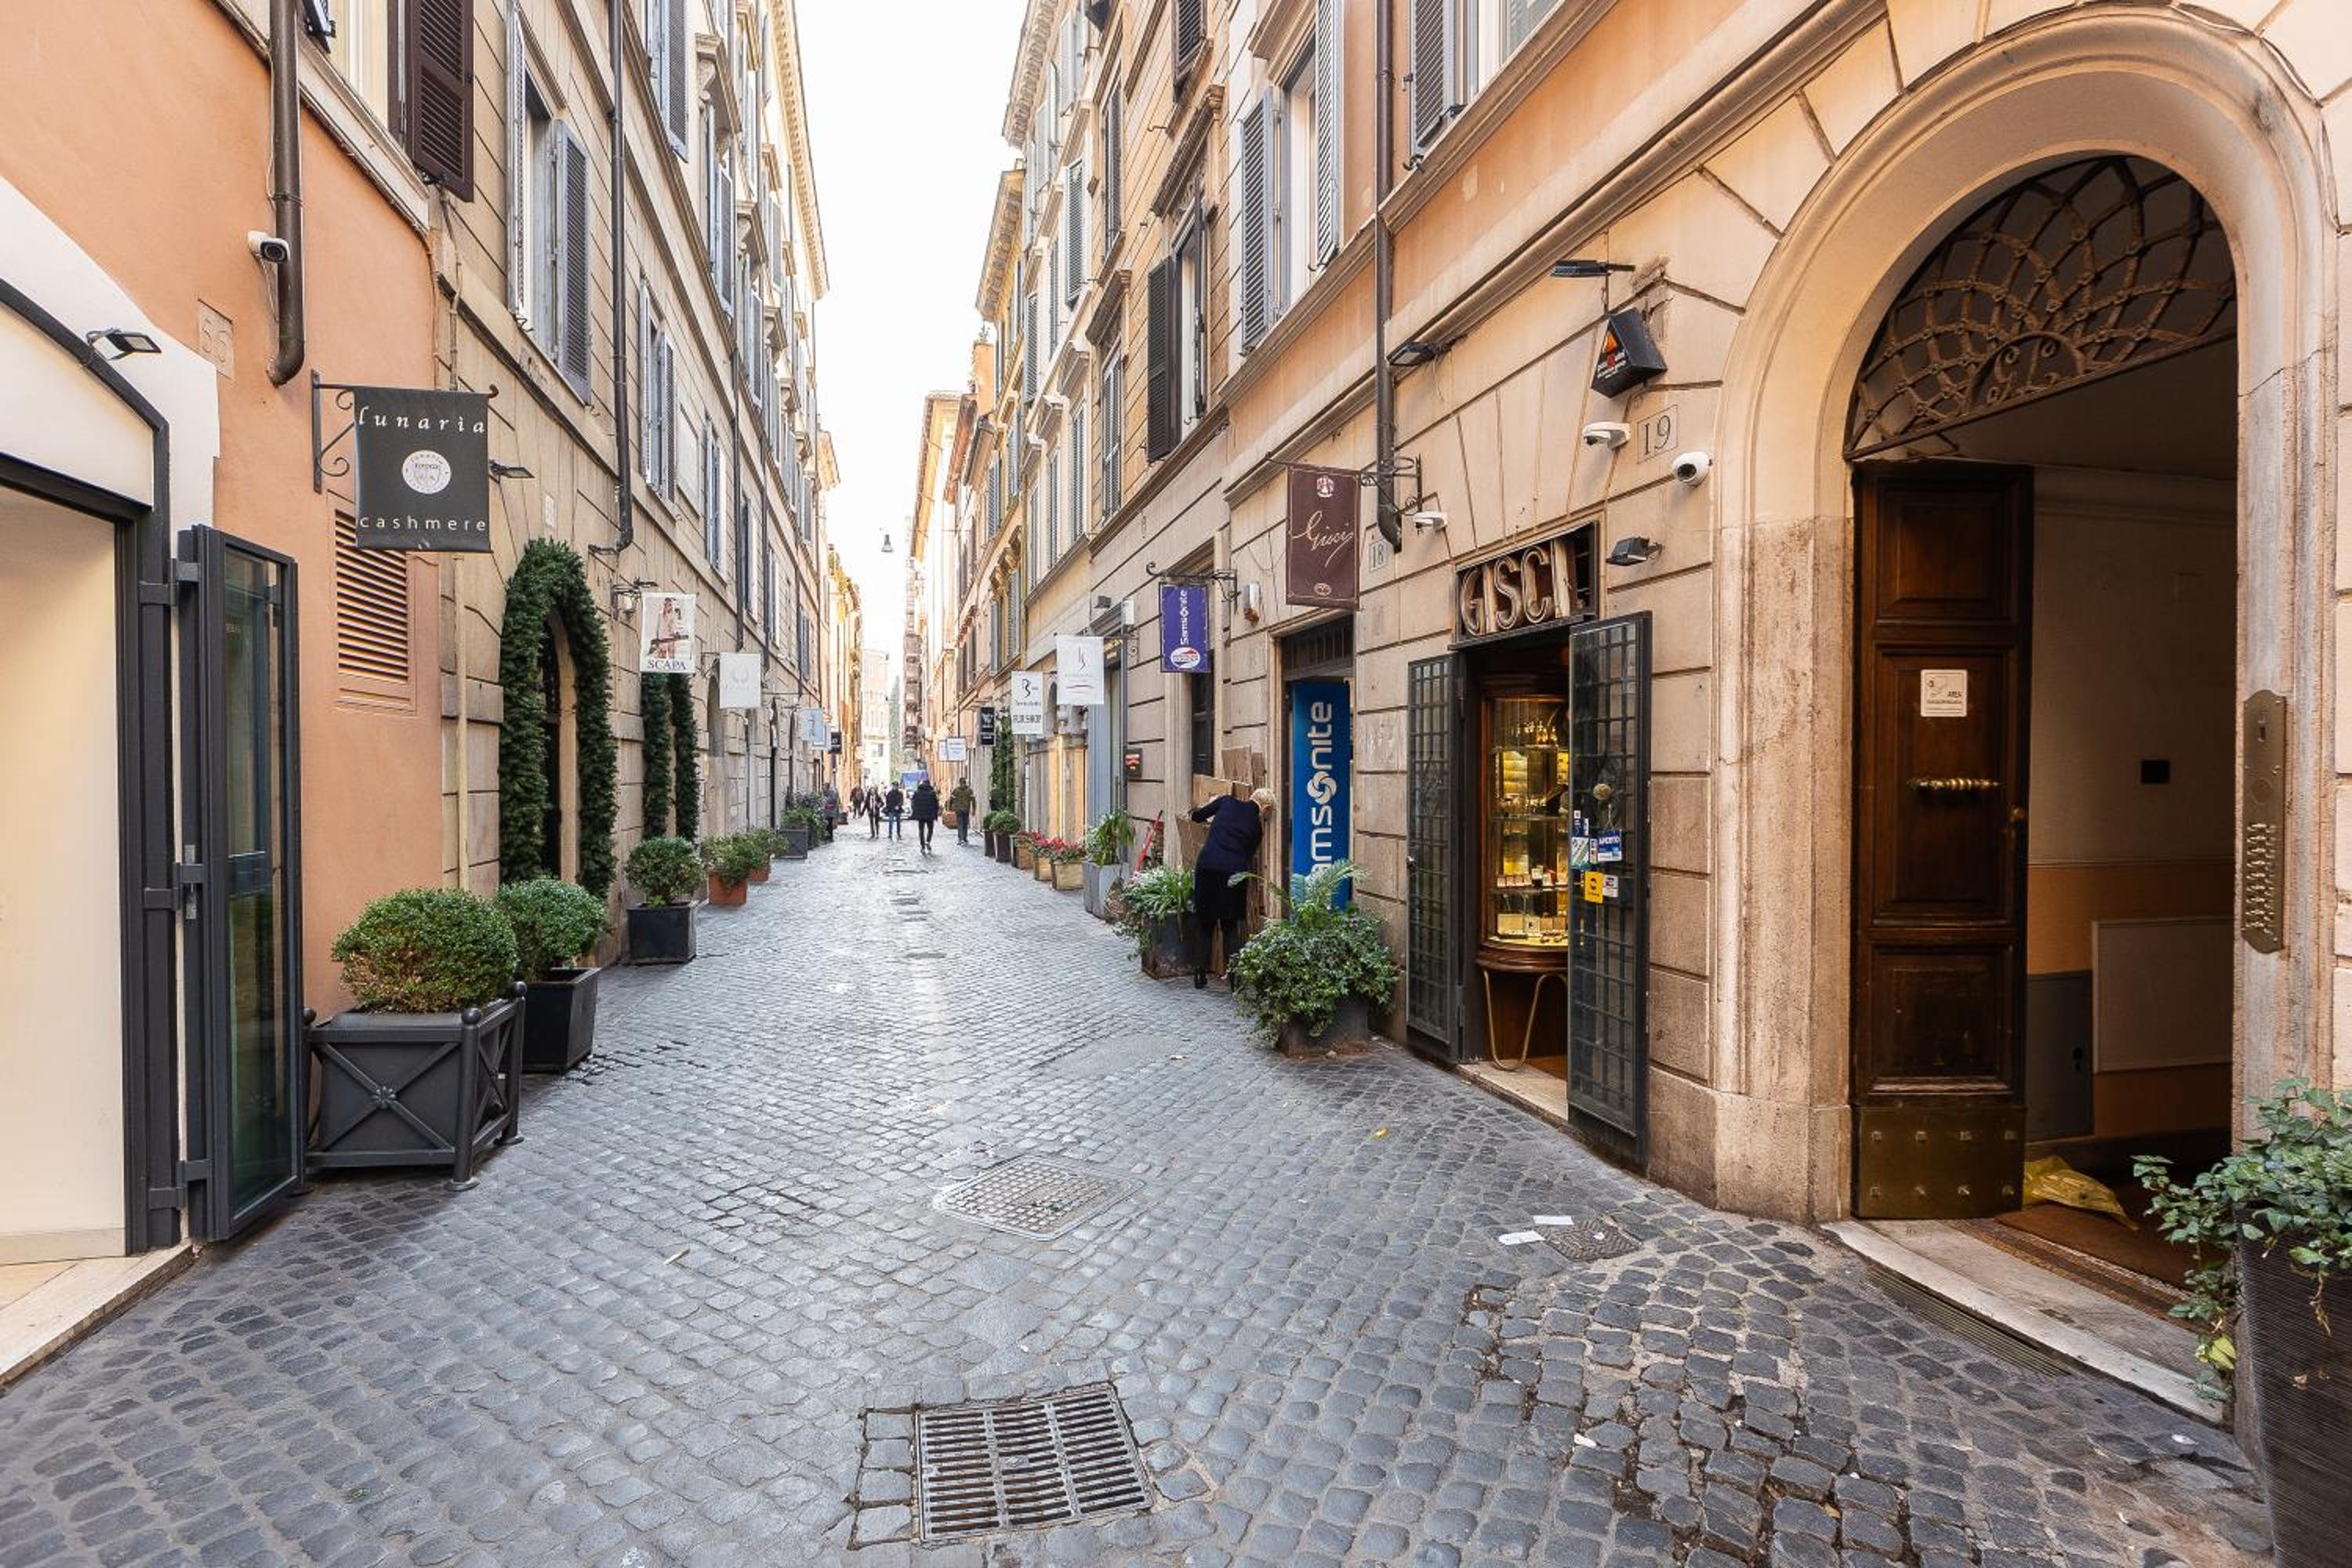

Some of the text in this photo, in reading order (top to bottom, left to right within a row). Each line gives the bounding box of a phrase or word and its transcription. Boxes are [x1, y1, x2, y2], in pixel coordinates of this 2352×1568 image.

[357, 405, 485, 434] lunaria
[1643, 414, 1671, 456] 19
[359, 514, 487, 532] cashmere
[1372, 543, 1385, 568] 18
[647, 659, 688, 672] SCAPA
[1307, 701, 1338, 880] amsonite
